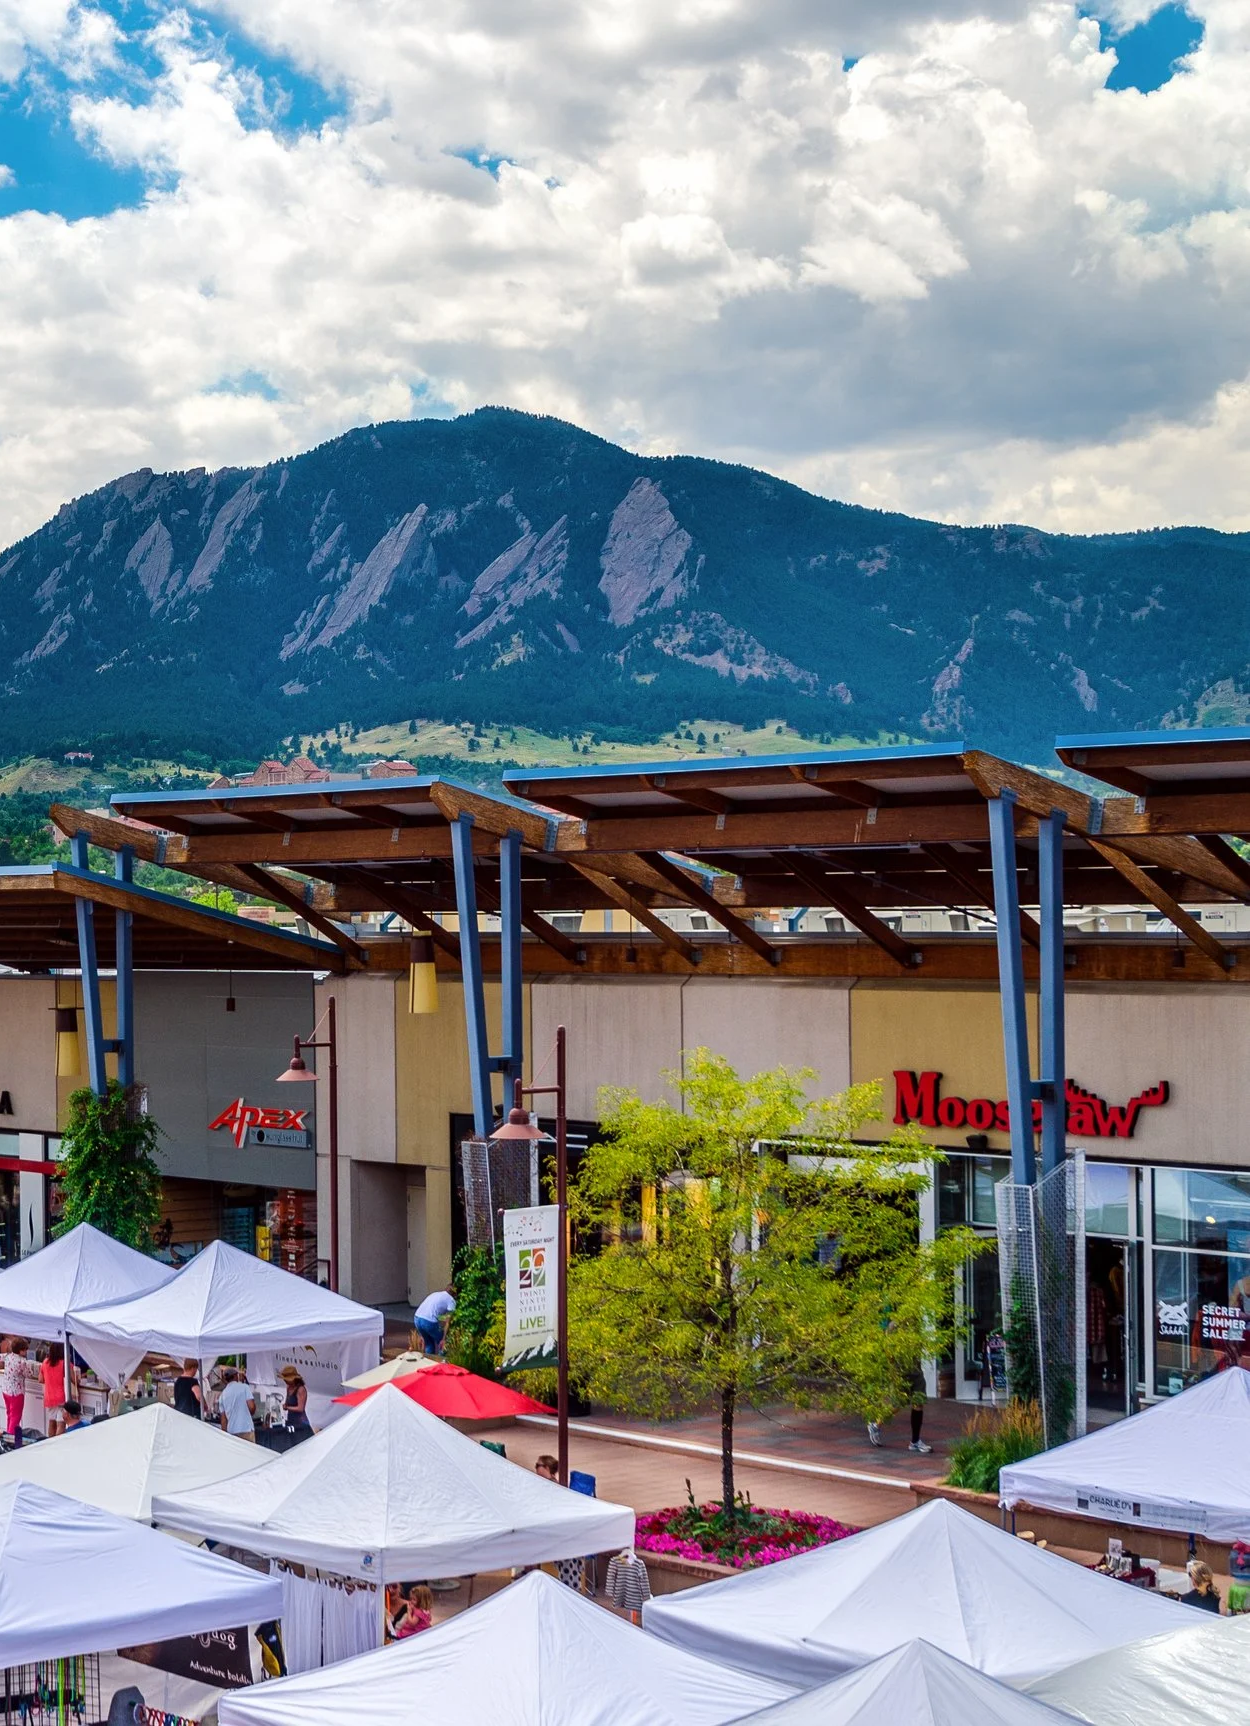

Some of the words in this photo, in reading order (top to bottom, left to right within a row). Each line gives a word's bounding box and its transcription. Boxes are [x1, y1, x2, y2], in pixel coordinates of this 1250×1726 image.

[519, 1250, 546, 1287] 29
[1202, 1304, 1241, 1317] SECRET
[519, 1315, 546, 1330] LIVE!
[1202, 1317, 1246, 1330] SUMMER
[1202, 1328, 1229, 1340] SALE
[1089, 1494, 1121, 1509] CHARLIE
[190, 1660, 226, 1679] Adventure
